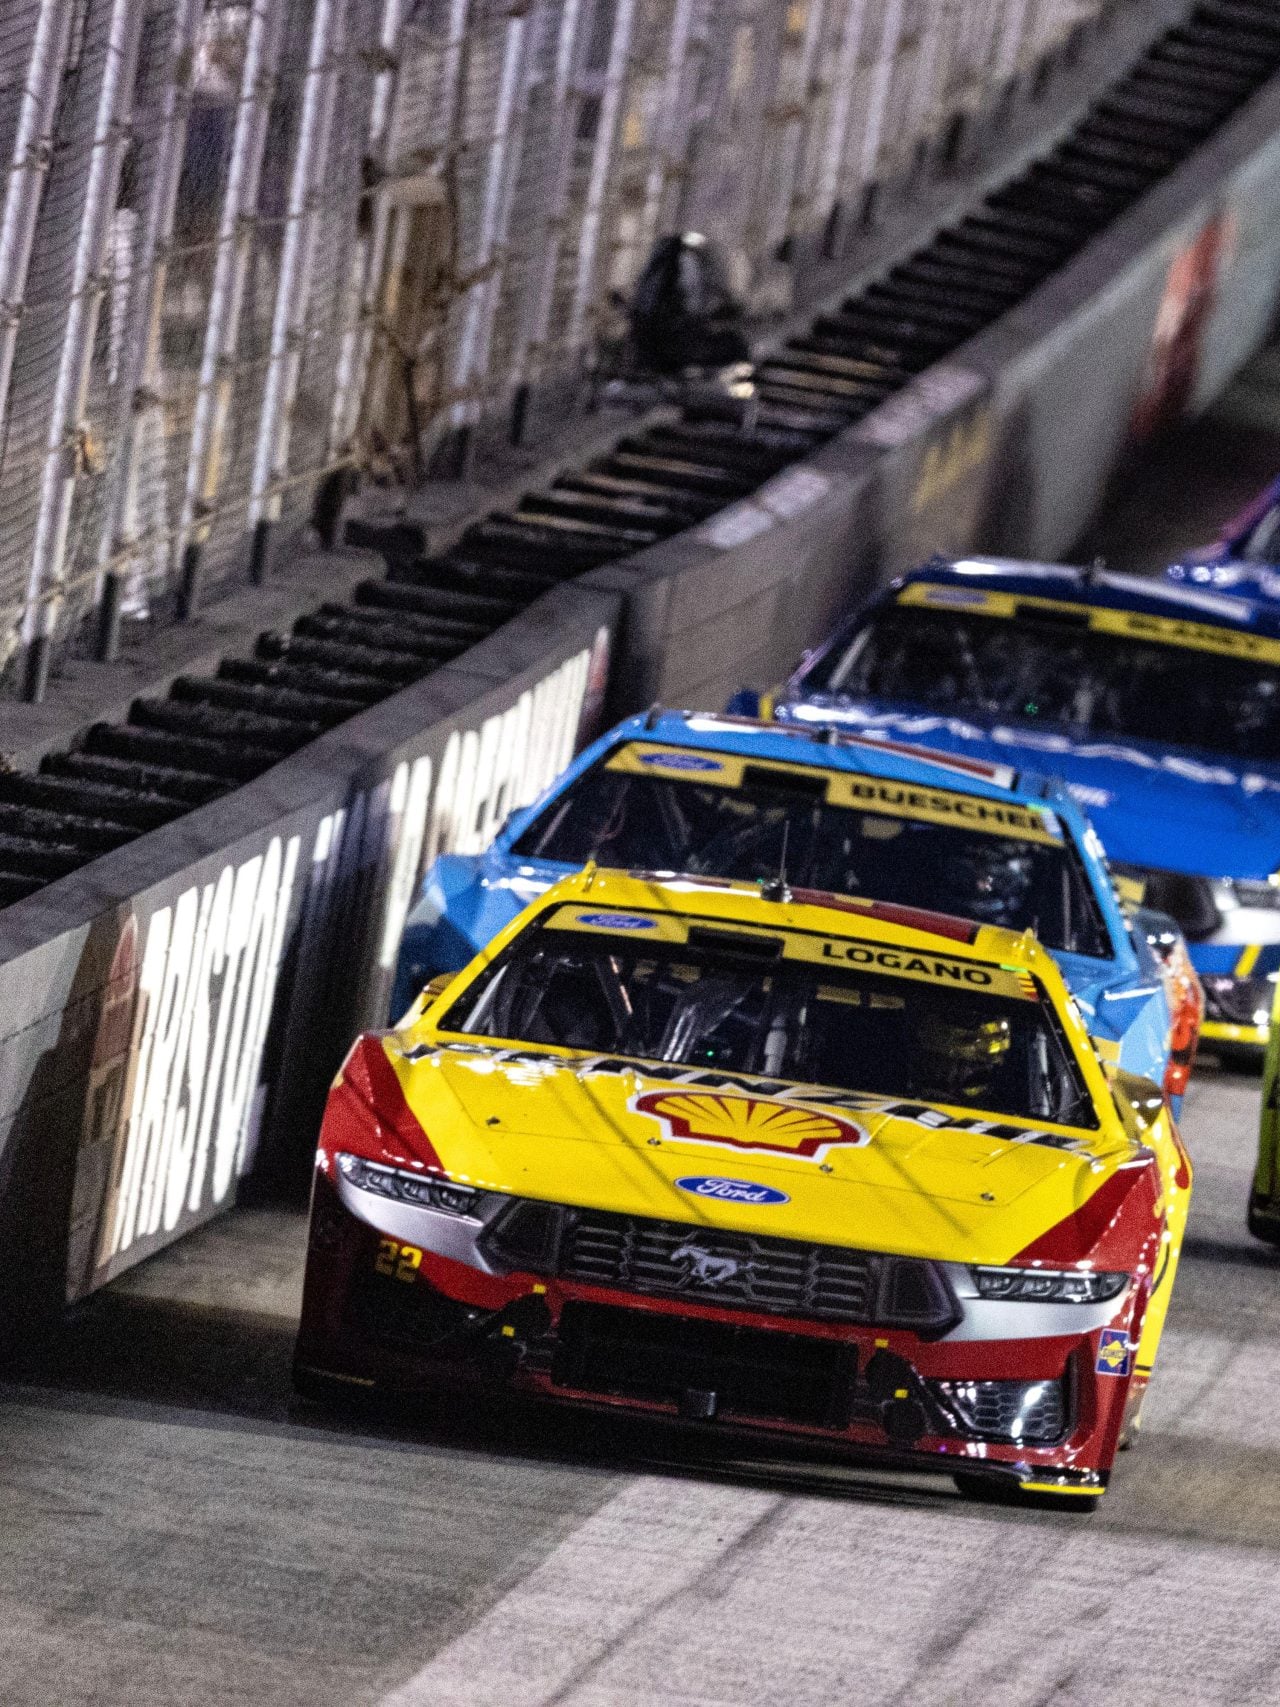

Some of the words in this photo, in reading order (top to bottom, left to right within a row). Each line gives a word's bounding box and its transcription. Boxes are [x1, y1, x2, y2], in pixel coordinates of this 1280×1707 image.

[823, 943, 992, 985] LOGANO
[697, 1180, 769, 1201] Ford
[375, 1240, 423, 1283] 22
